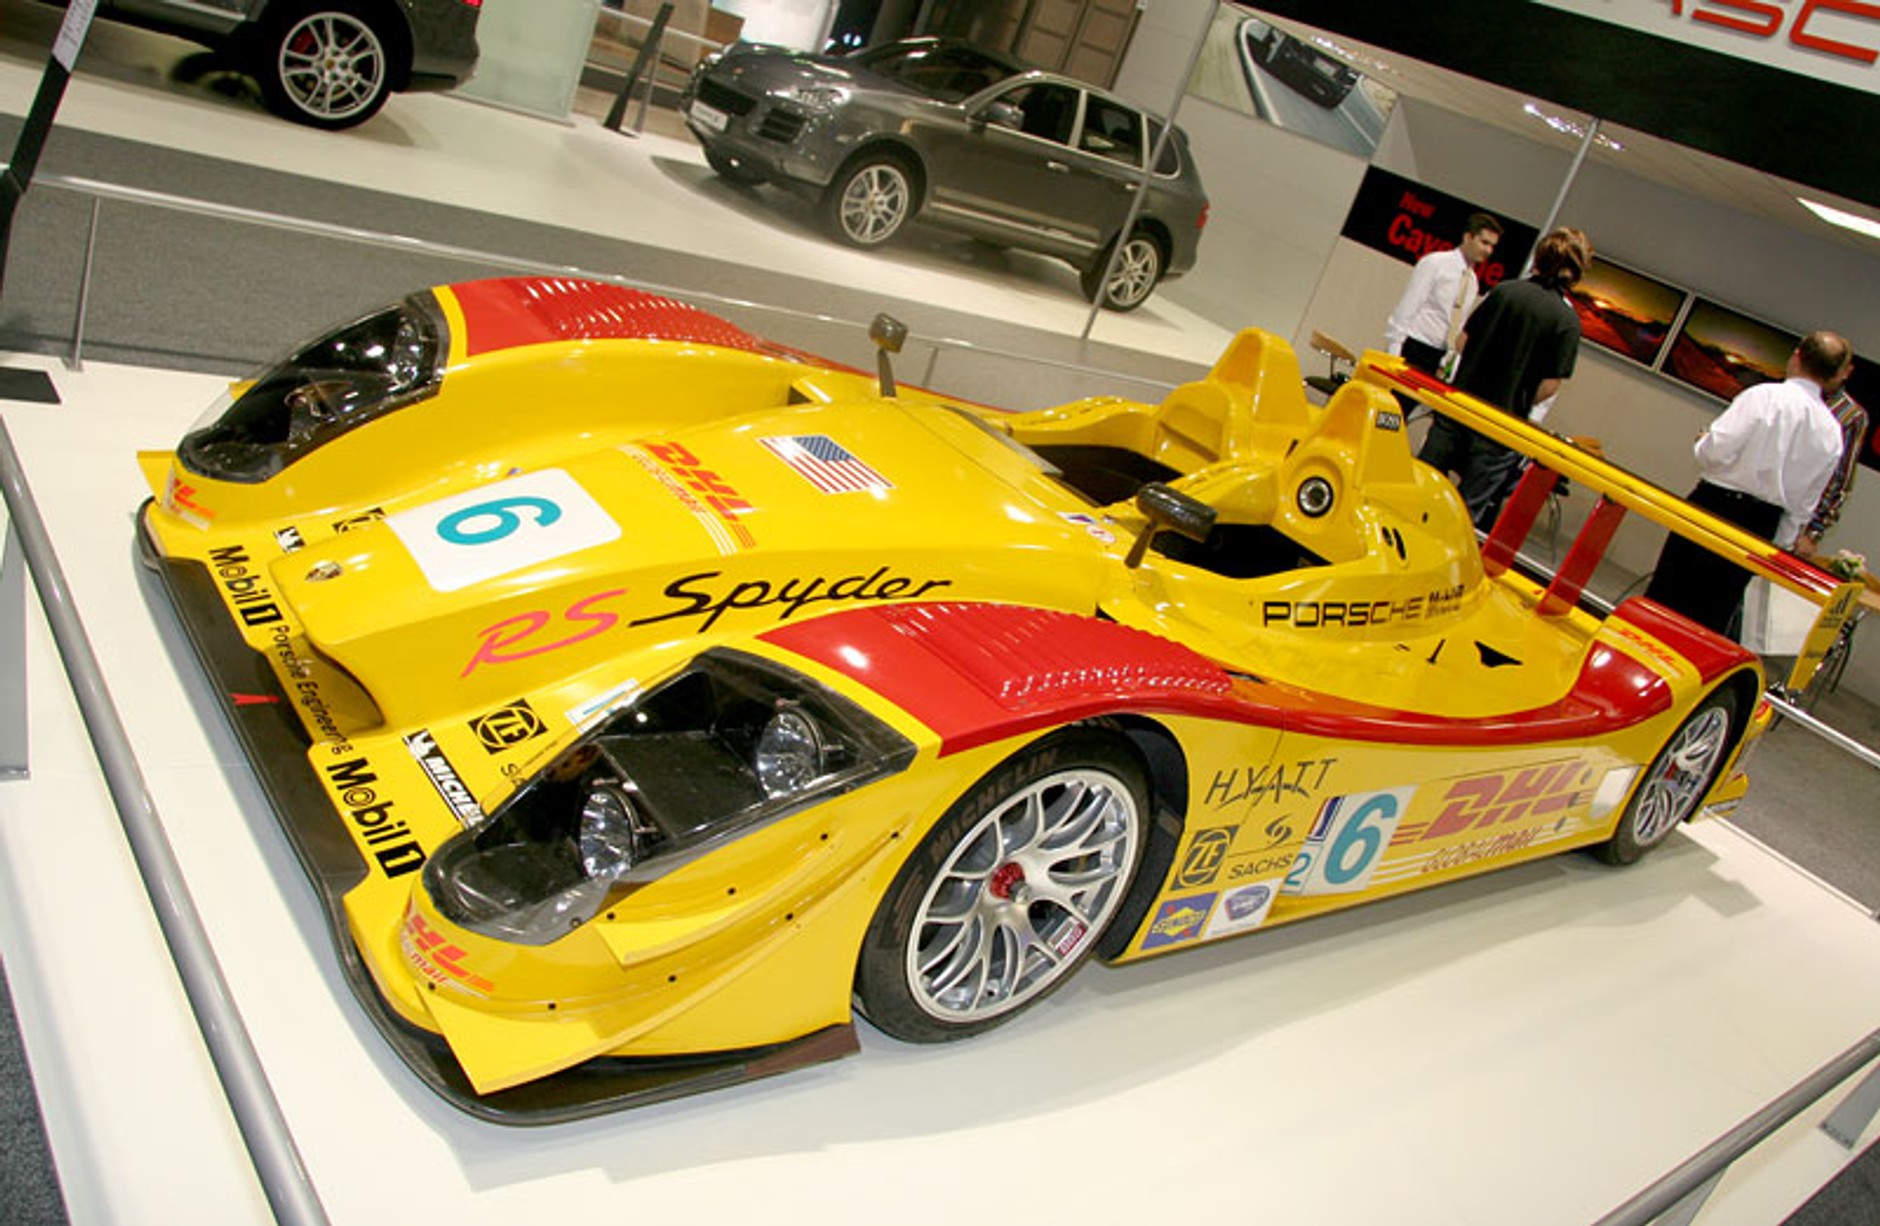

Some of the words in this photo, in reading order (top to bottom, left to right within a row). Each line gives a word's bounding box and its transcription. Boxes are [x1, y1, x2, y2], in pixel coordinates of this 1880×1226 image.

[642, 441, 753, 522] DHL
[436, 496, 562, 546] 6
[208, 545, 272, 605] Mobil
[461, 589, 628, 677] RS
[628, 567, 952, 632] Spyder
[1263, 597, 1424, 627] PORSCHE
[326, 757, 412, 846] Mobil
[1204, 758, 1338, 807] HYATT
[1420, 761, 1586, 842] DHL
[1229, 852, 1294, 880] SACHS
[1324, 793, 1399, 885] 6
